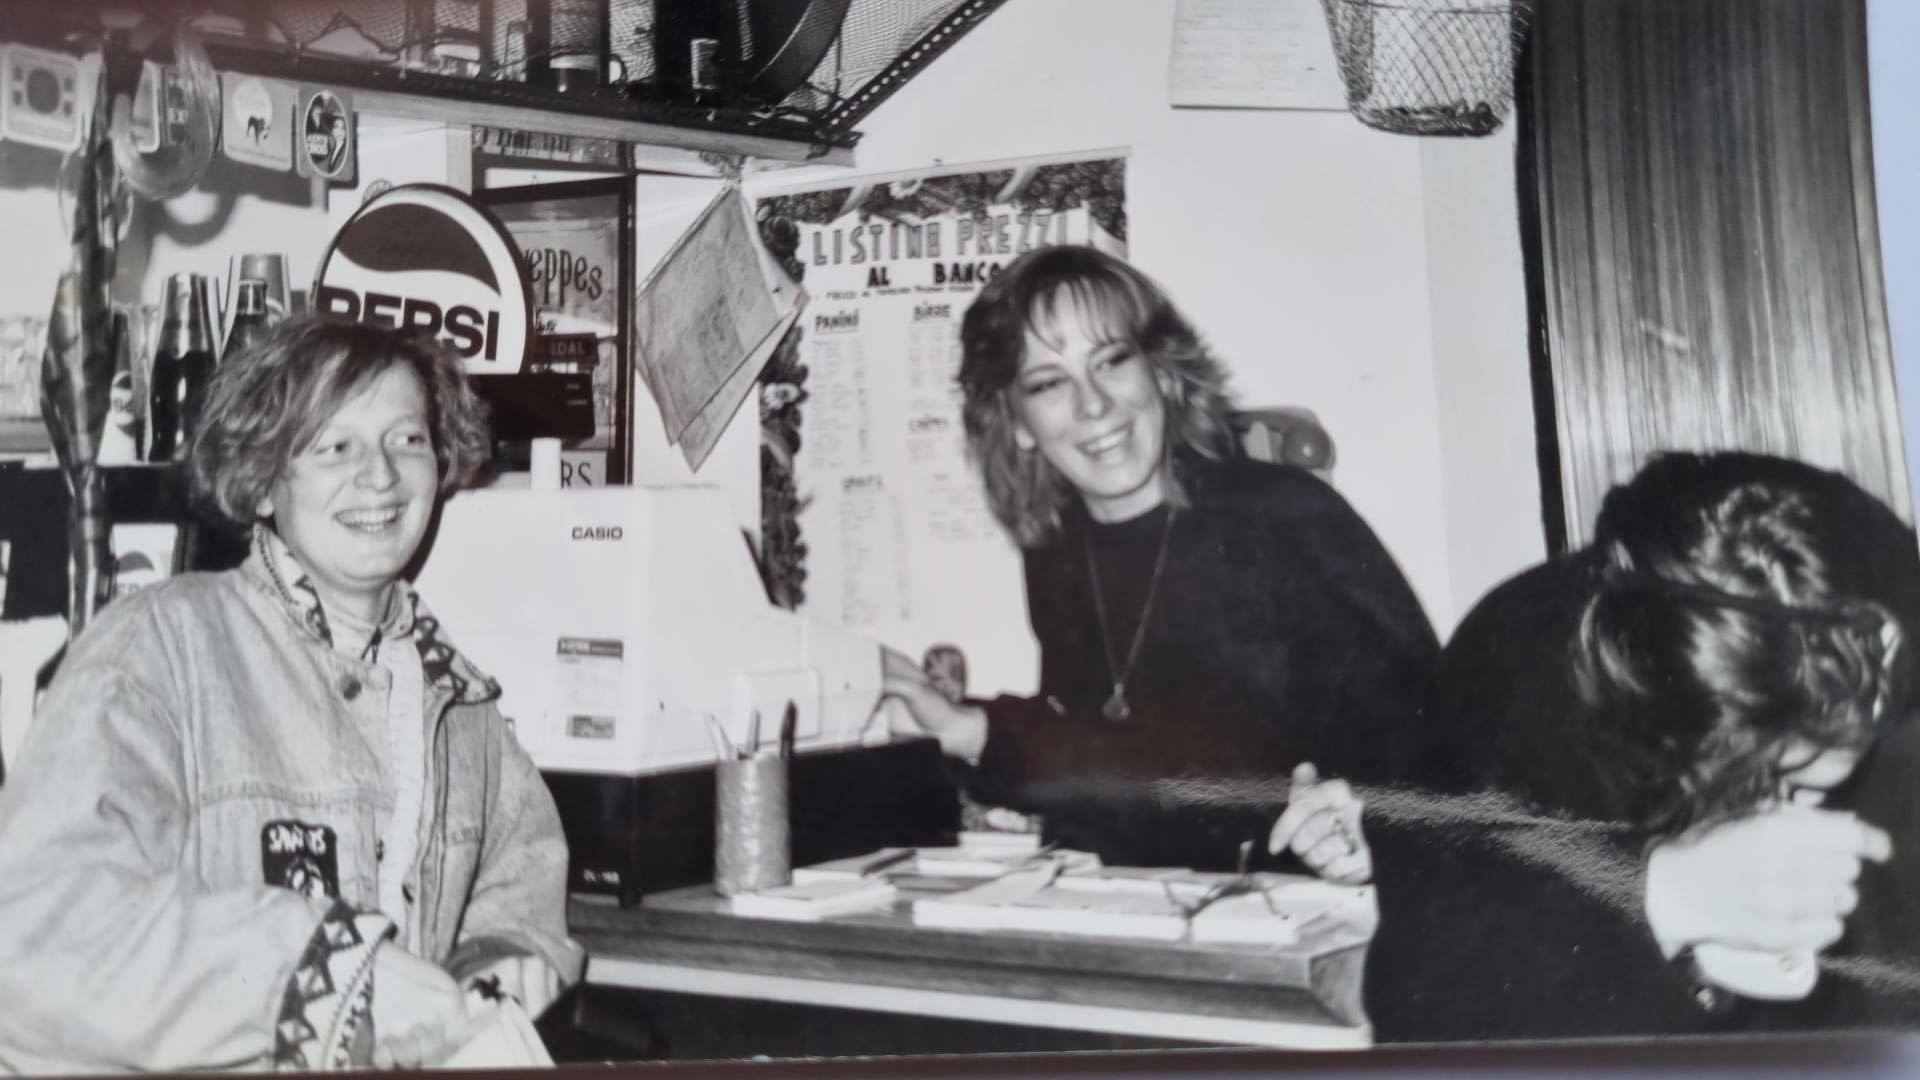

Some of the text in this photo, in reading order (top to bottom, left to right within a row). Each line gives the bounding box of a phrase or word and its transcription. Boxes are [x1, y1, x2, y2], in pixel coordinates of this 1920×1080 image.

[957, 211, 1066, 255] PREZZI
[525, 248, 603, 307] eppes
[867, 266, 890, 287] AL
[314, 286, 500, 361] PEPSI
[571, 526, 623, 540] CASIO
